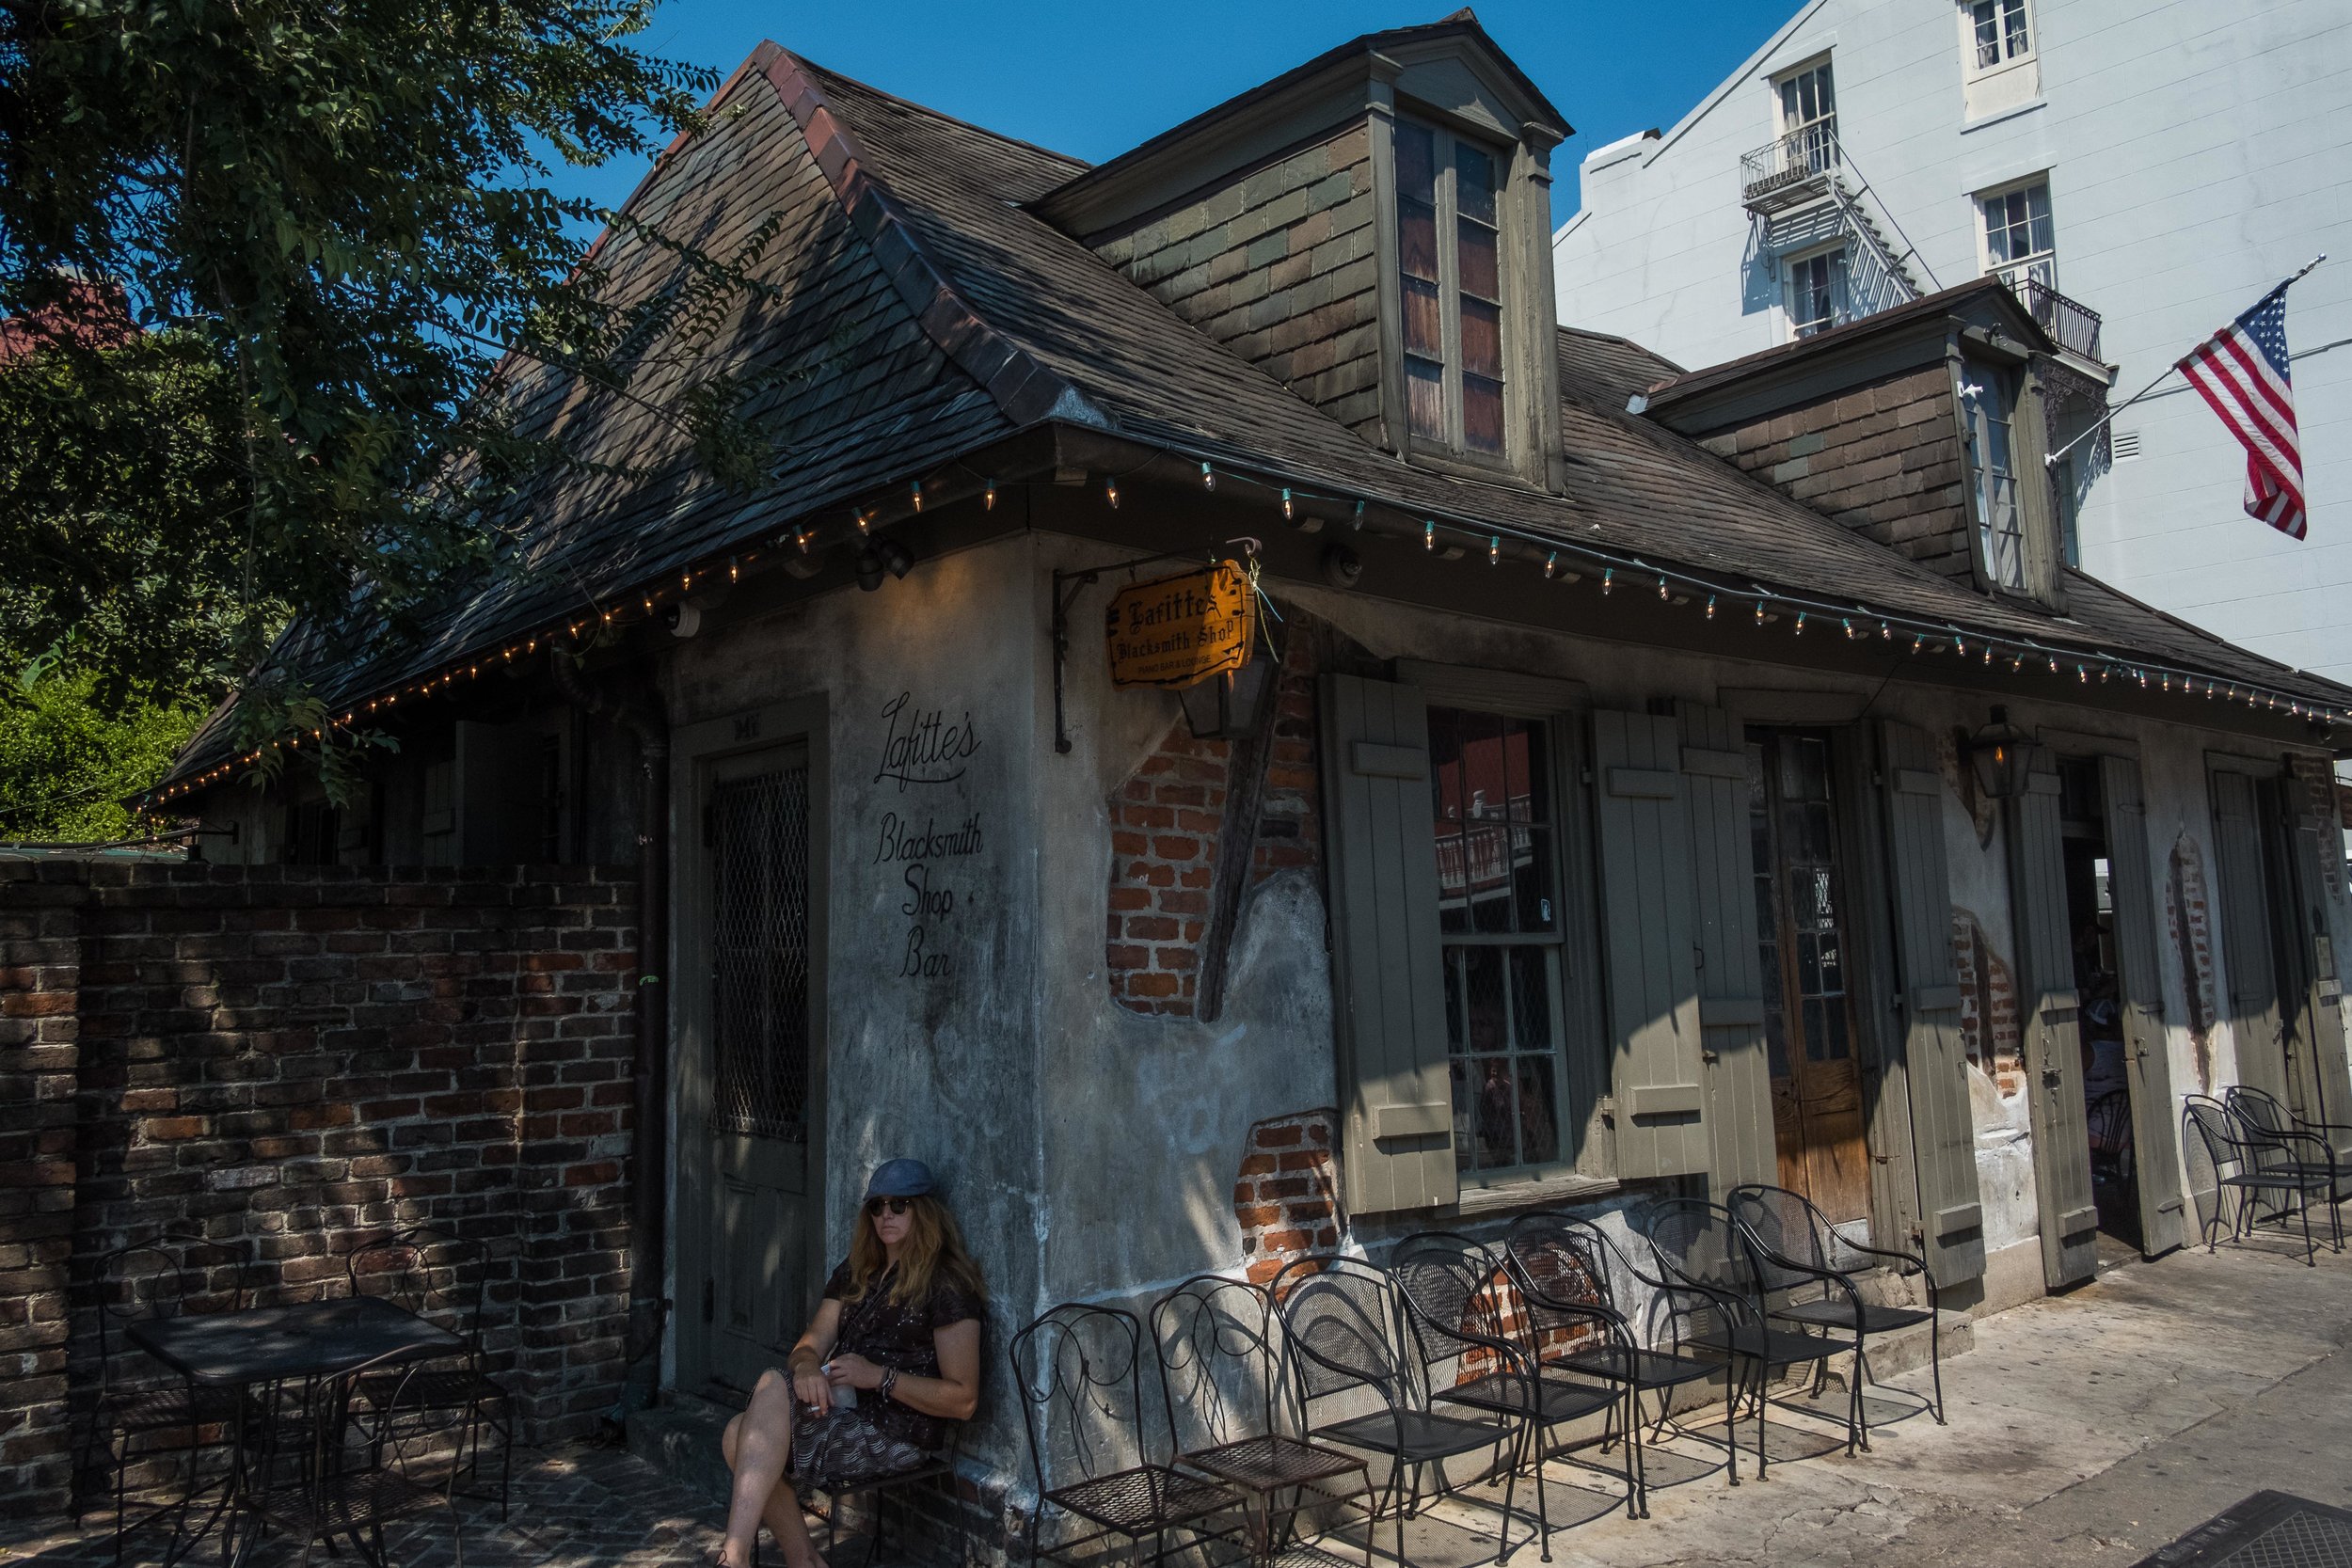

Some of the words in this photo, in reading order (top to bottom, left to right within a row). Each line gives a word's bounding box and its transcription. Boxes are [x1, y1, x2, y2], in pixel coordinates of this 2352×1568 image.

[1117, 631, 1190, 663] Blacksmith
[1197, 619, 1234, 647] Shop
[874, 691, 981, 793] Lafitte's
[873, 813, 983, 864] Blacksmith
[902, 863, 953, 923] Shop
[899, 926, 951, 977] Bar
